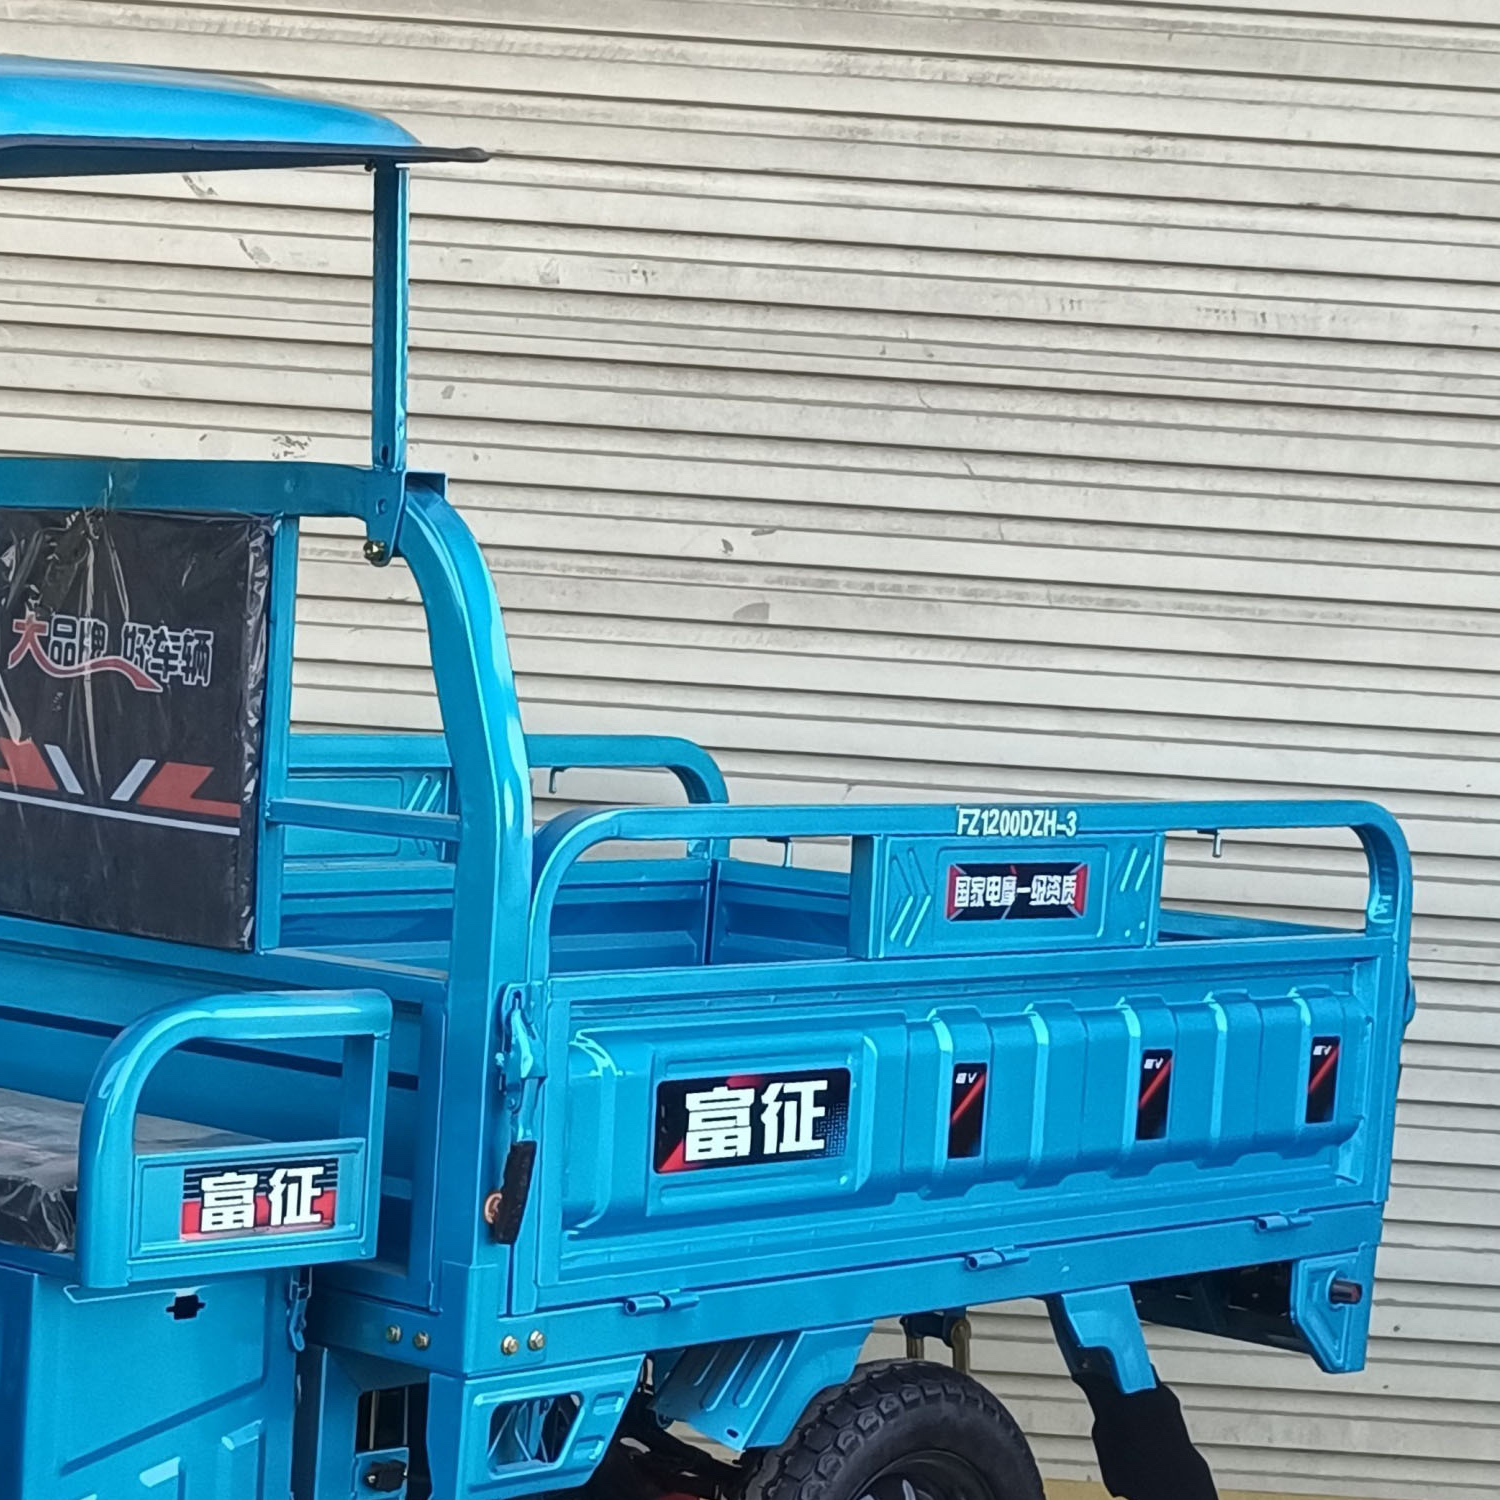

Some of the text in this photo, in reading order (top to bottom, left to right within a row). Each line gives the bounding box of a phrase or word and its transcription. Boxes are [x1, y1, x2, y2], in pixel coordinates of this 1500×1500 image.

[956, 807, 1078, 837] FZ1200DZH-3
[684, 1079, 829, 1162] 富征
[201, 1166, 325, 1233] 富征
